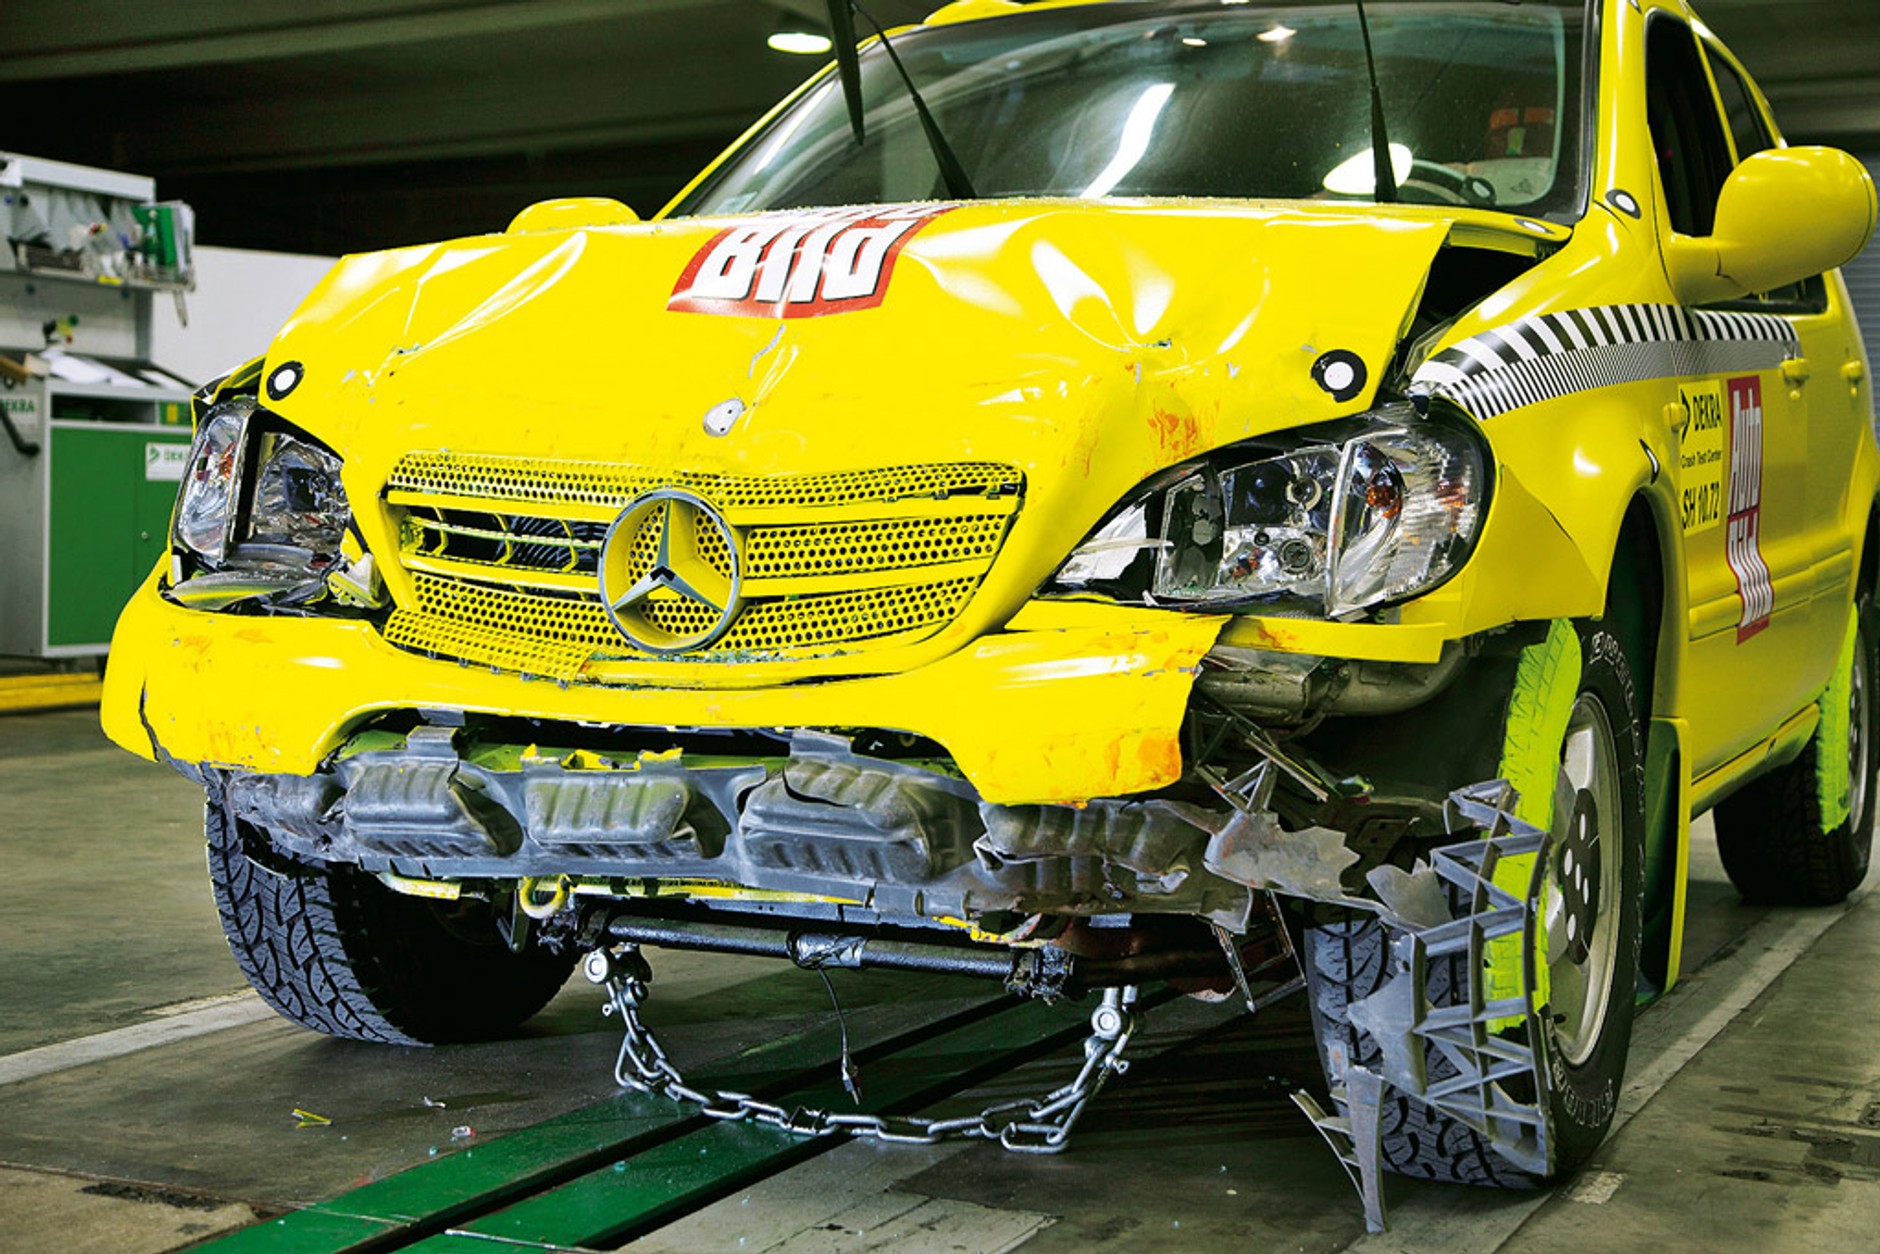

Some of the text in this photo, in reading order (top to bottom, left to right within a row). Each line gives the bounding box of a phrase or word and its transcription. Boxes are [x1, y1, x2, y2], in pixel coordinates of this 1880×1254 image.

[1693, 393, 1721, 431] DEKRA
[1681, 454, 1696, 469] Crash
[1696, 450, 1707, 465] Test
[1682, 486, 1696, 530] SH
